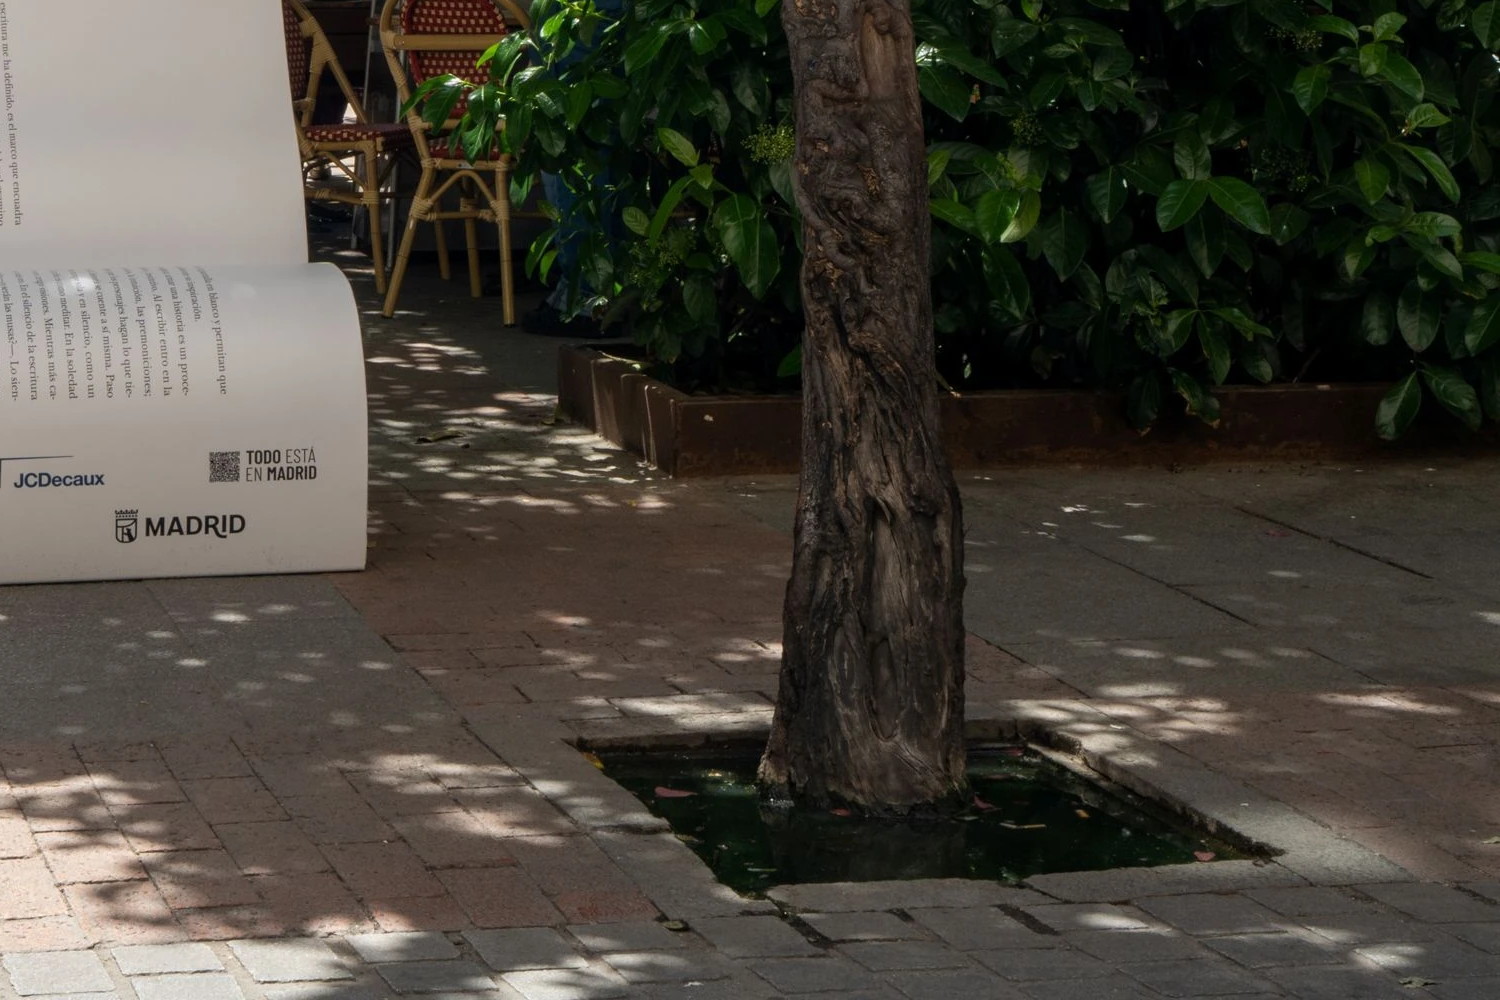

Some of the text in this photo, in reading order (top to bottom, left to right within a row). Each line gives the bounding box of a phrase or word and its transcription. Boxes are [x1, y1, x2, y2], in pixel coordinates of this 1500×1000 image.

[0, 2, 9, 41] escritura
[2, 43, 9, 57] me
[3, 59, 12, 71] ha
[4, 72, 15, 111] definido,
[7, 113, 13, 122] es
[8, 123, 17, 131] el
[9, 133, 17, 160] marco
[9, 162, 18, 179] que
[13, 181, 23, 226] encuadra
[173, 301, 185, 332] historia
[60, 297, 78, 399] meditar. En la soledad
[178, 334, 185, 345] es
[118, 316, 134, 398] hagan lo que tie-
[179, 347, 187, 360] un
[178, 363, 188, 396] proce-
[246, 446, 316, 465] TODO ESTÁ
[14, 472, 105, 488] JCDecaux
[246, 465, 317, 482] EN MADRID
[145, 514, 246, 539] MADRID
